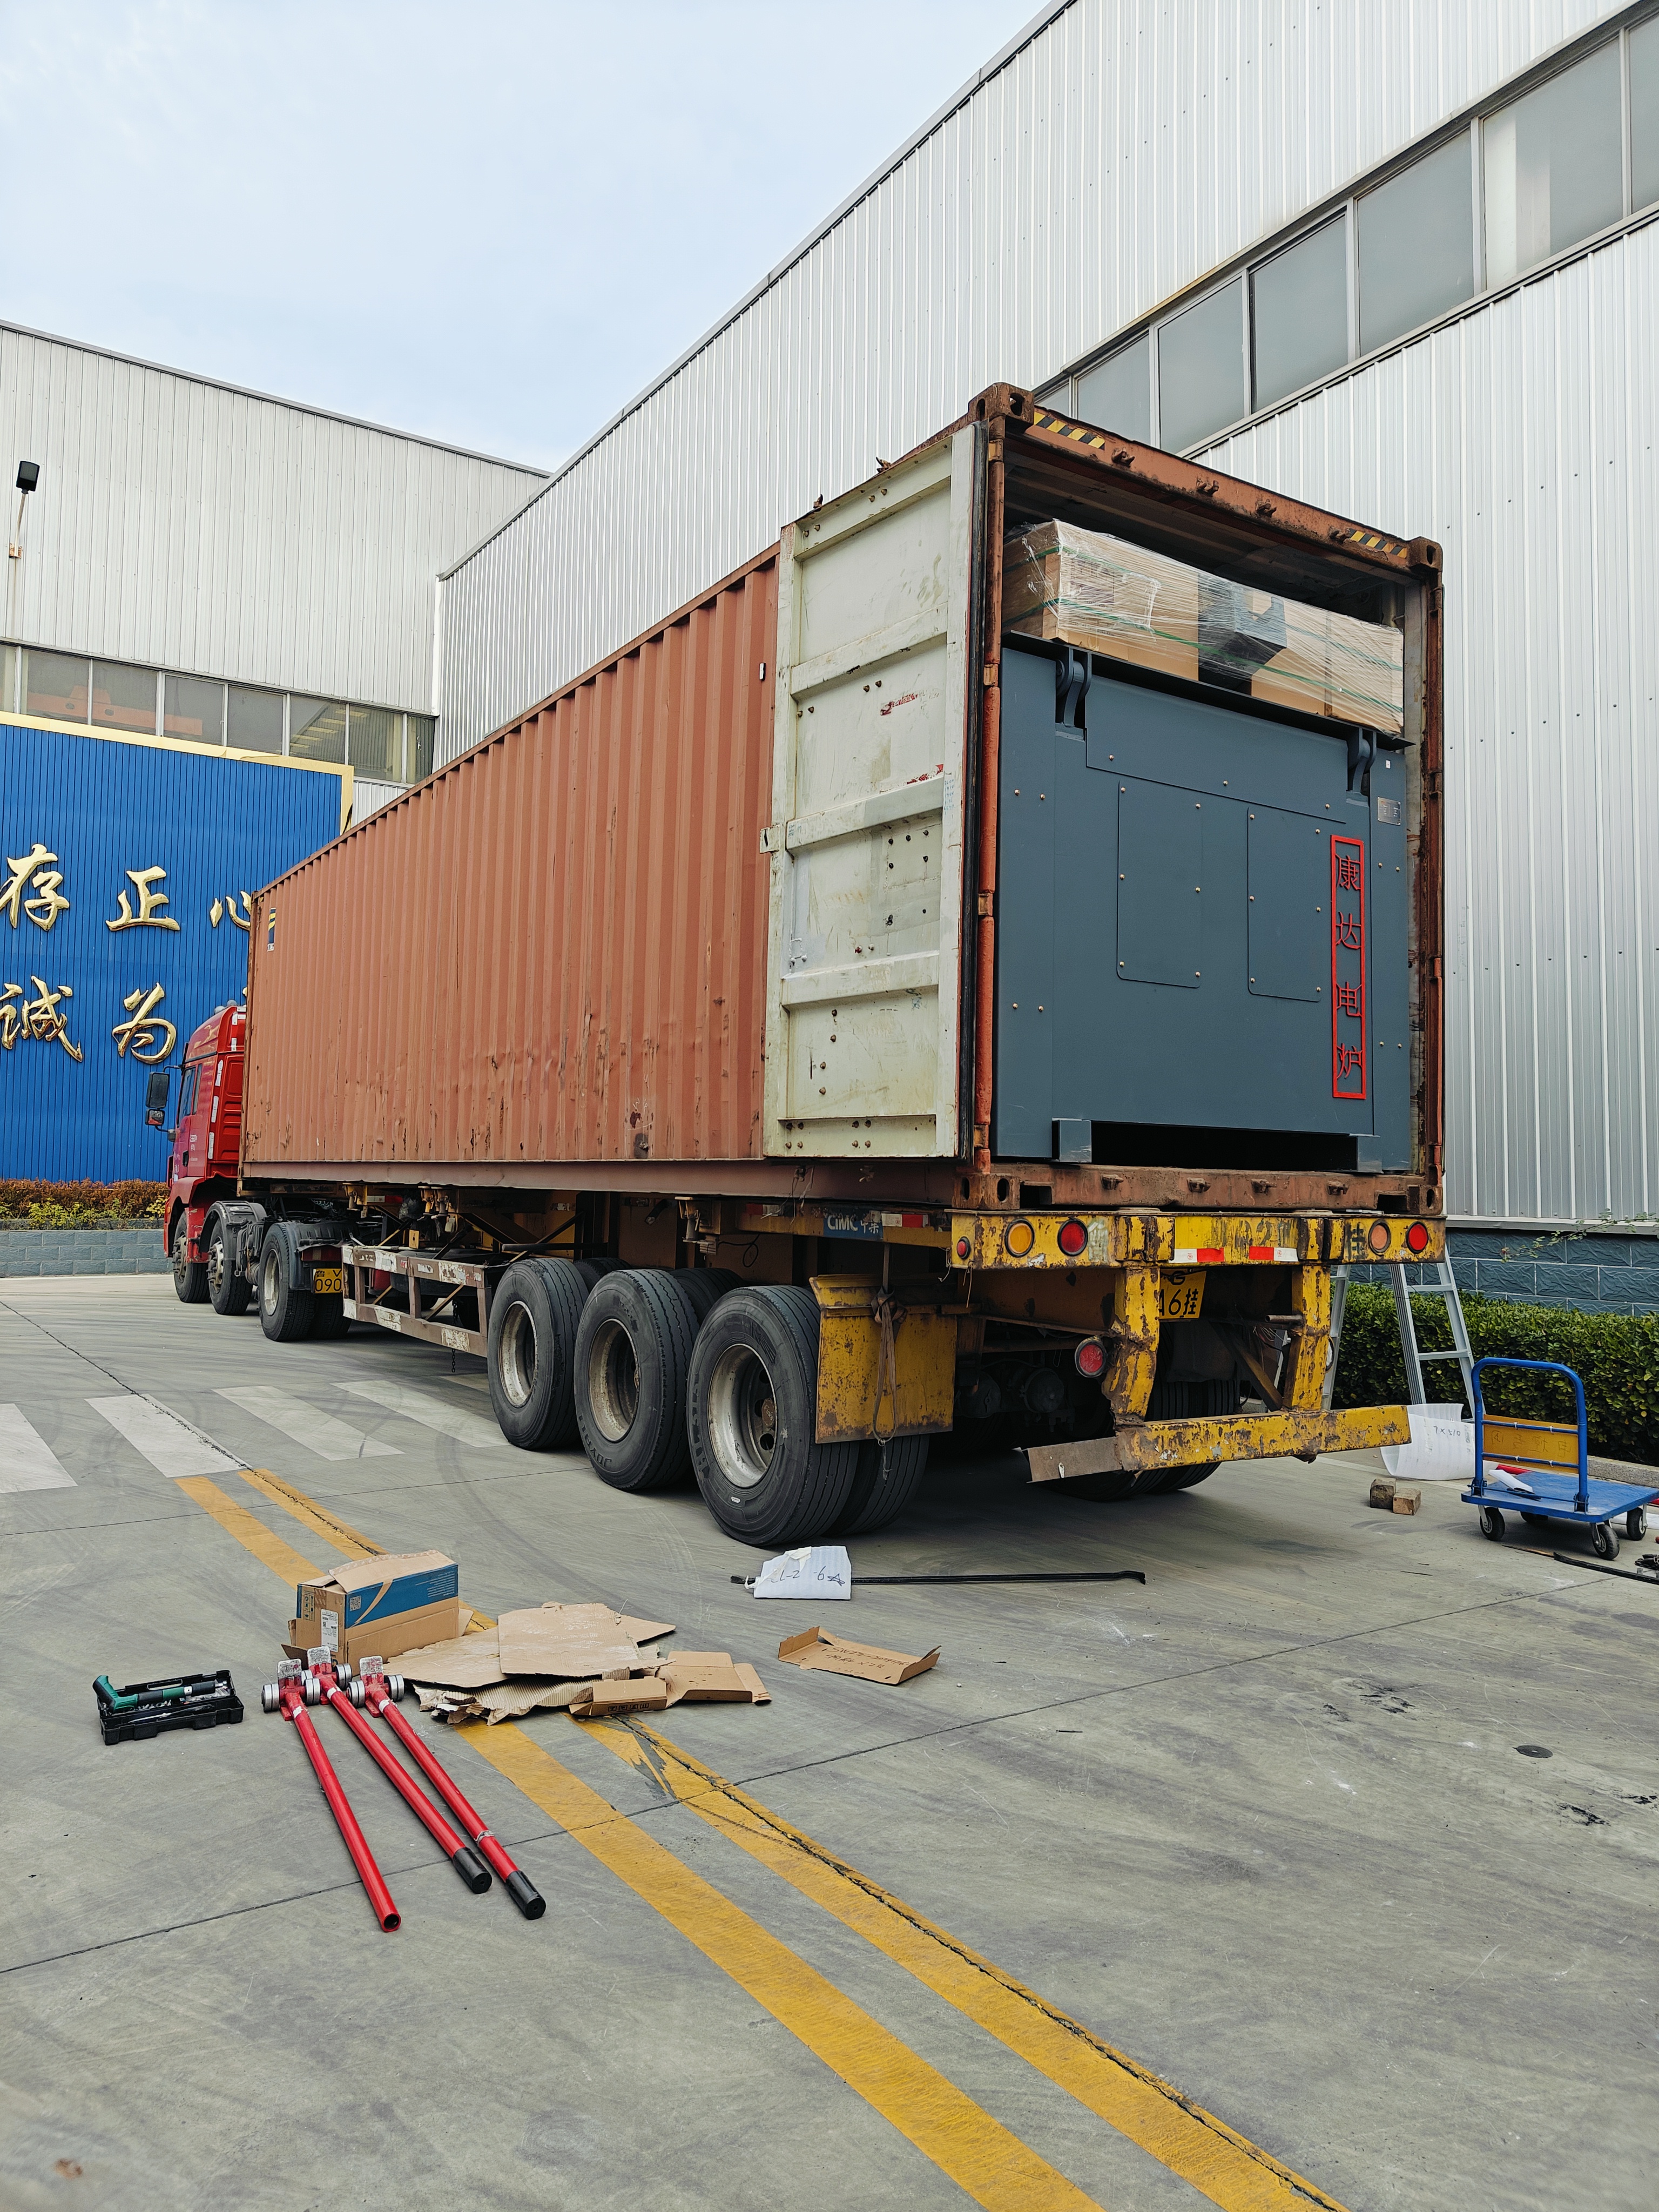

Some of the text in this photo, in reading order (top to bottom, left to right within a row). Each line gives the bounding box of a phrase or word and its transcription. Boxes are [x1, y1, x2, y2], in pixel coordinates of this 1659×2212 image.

[1335, 854, 1363, 1080] 康达电炉
[0, 975, 247, 1064] 诚为
[827, 1215, 858, 1231] CIMC
[315, 1278, 341, 1292] 090
